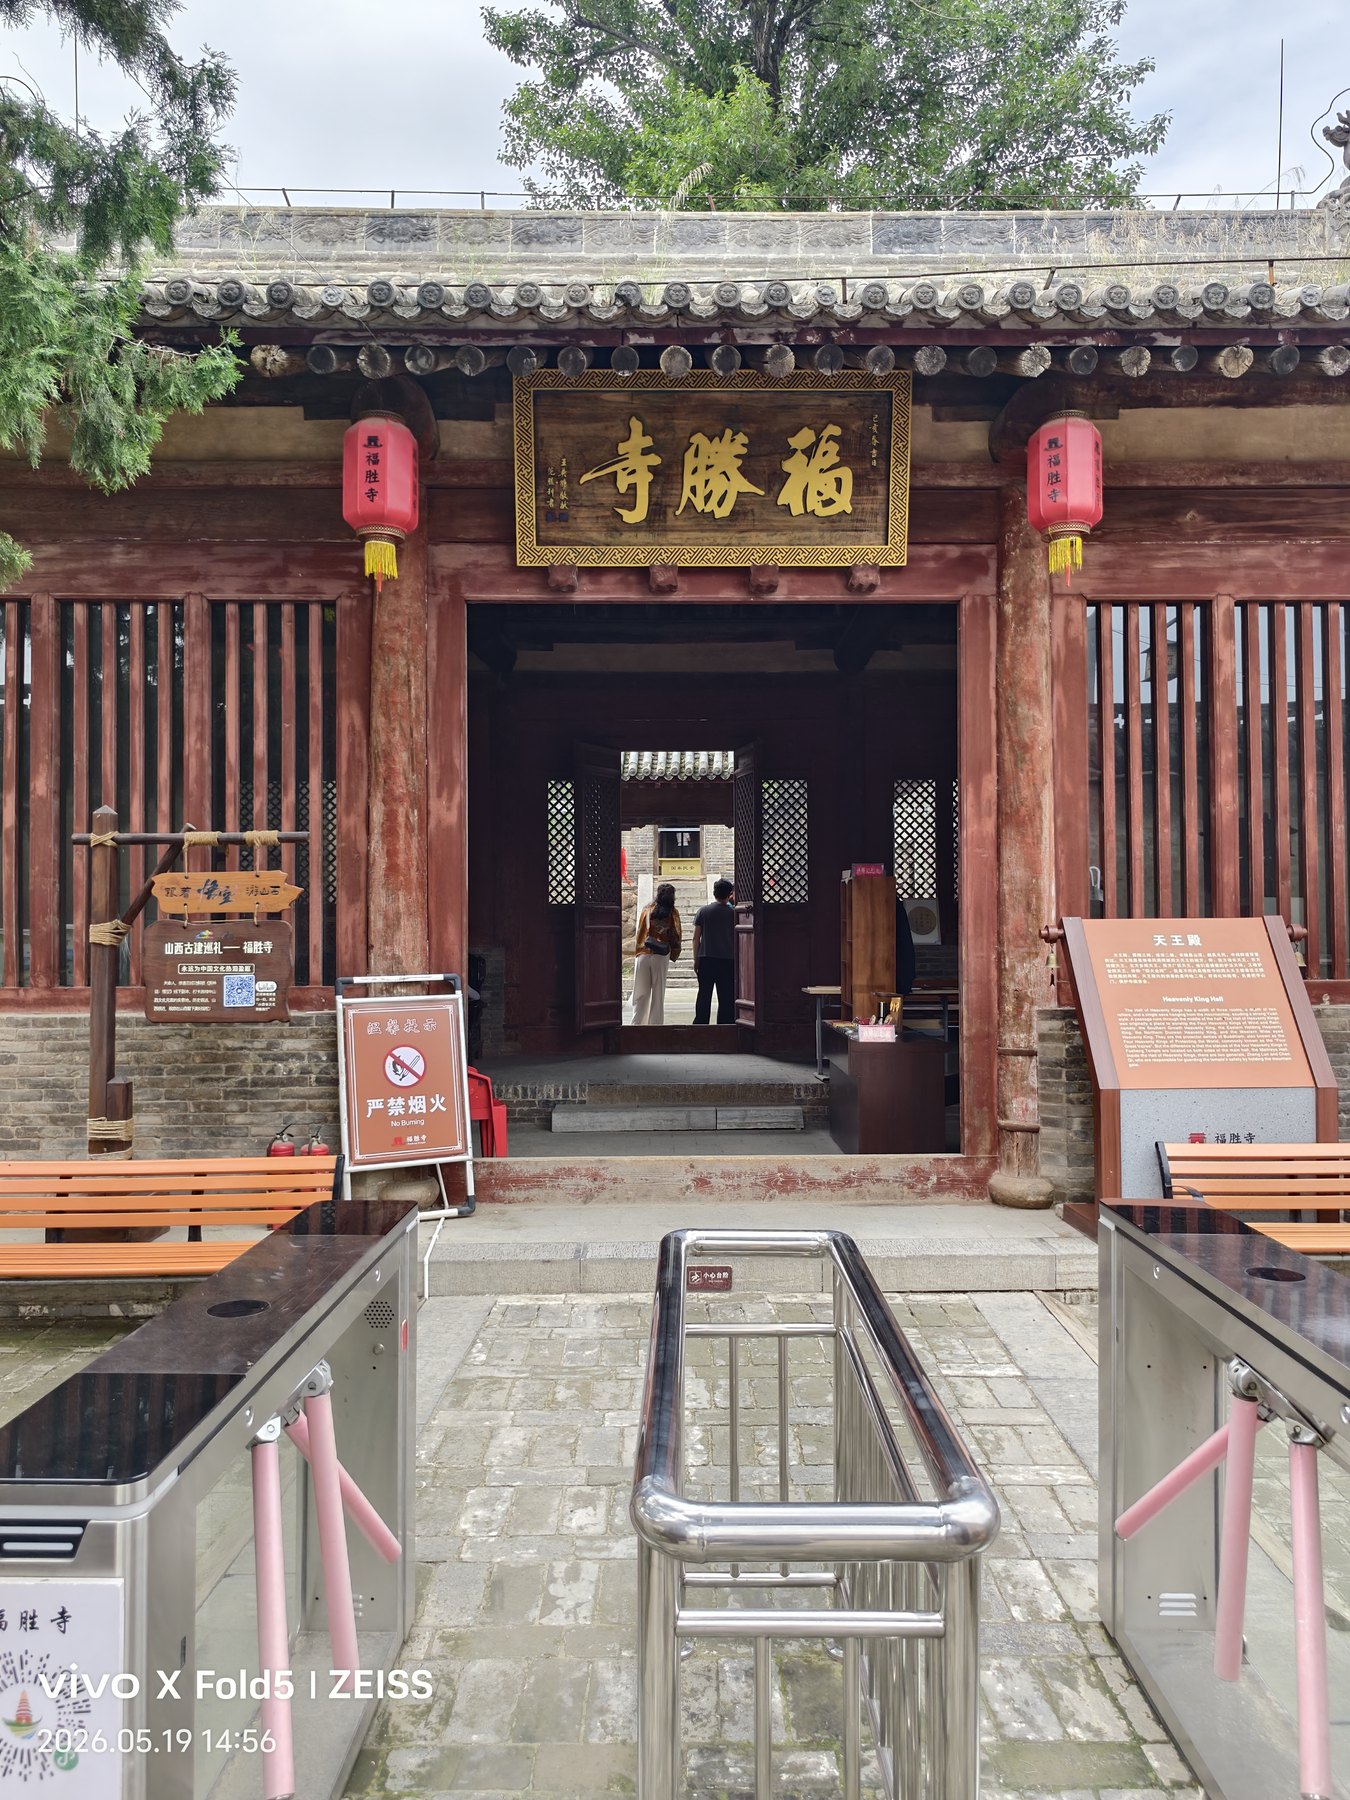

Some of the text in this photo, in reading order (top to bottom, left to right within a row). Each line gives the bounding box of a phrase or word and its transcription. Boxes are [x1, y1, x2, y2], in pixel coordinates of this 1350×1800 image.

[364, 452, 380, 503] 福胜寺
[579, 415, 853, 524] 福勝寺
[1047, 453, 1062, 503] 福胜寺
[164, 886, 191, 898] 跟着
[197, 878, 235, 905] 悟空
[1152, 934, 1203, 946] 天王殿
[1162, 995, 1193, 1003] Heavenly
[367, 1018, 437, 1035] 温馨提示
[366, 1093, 447, 1118] 严禁烟火
[401, 1118, 425, 1126] Burning
[1214, 1132, 1256, 1144] 福胜寺
[703, 1271, 729, 1279] 小心台阶
